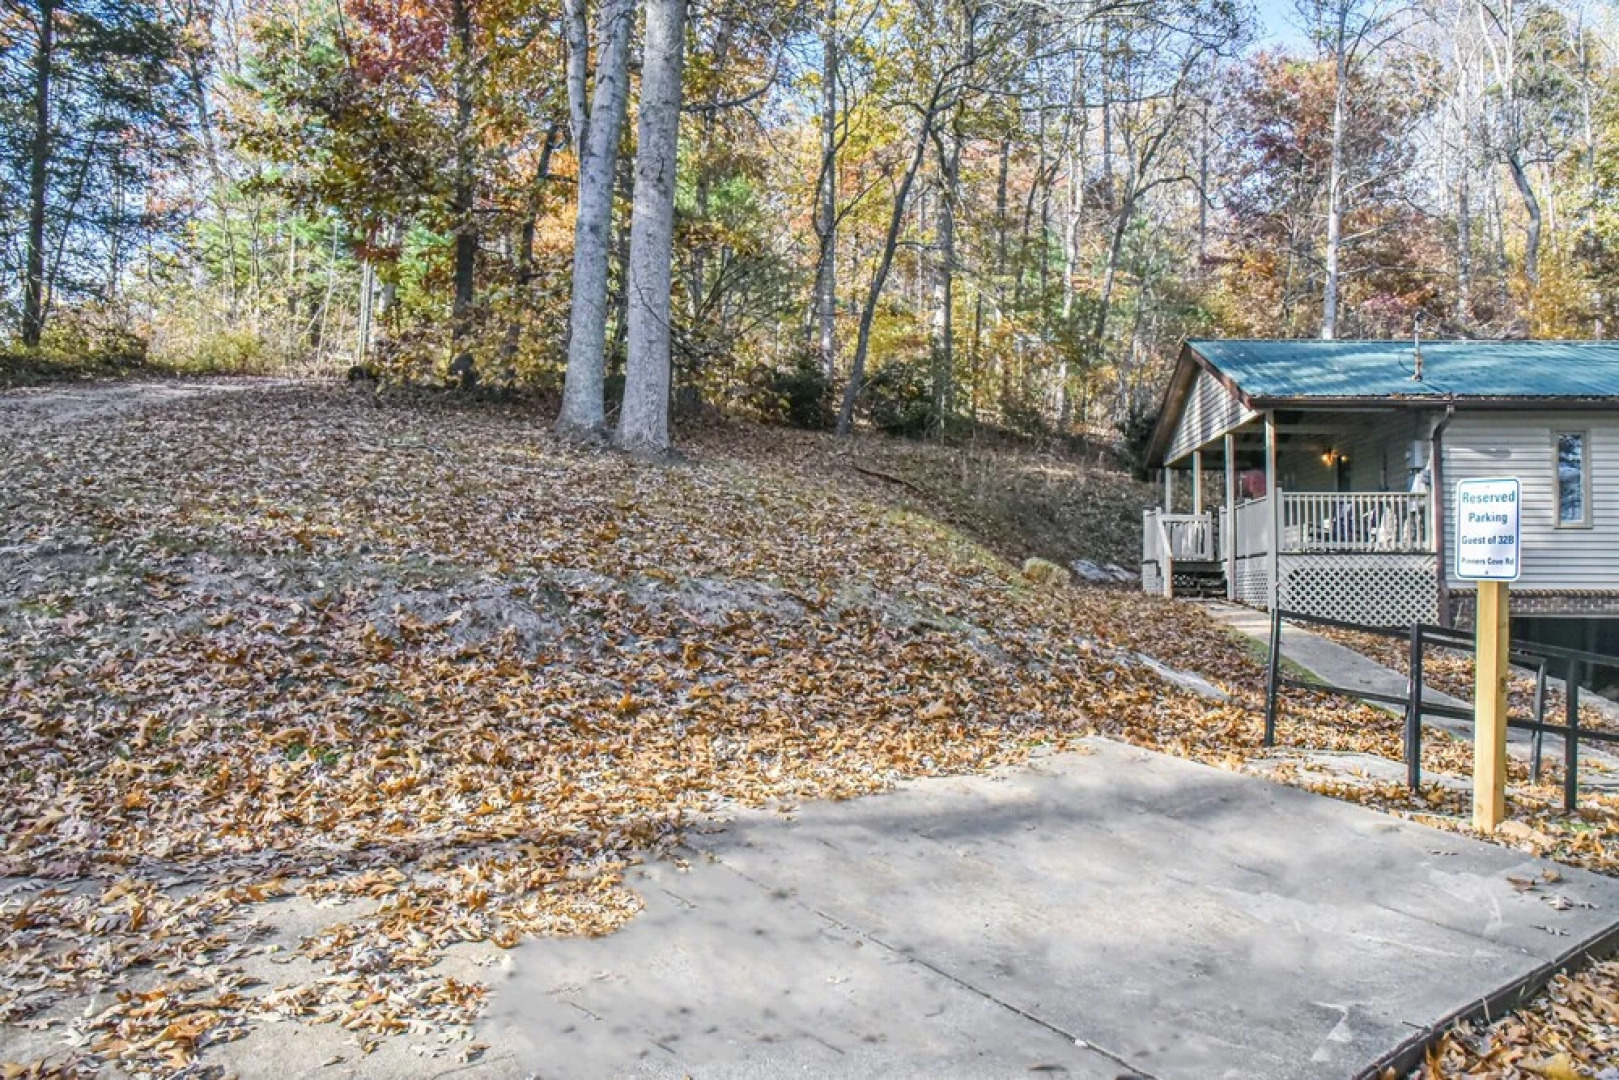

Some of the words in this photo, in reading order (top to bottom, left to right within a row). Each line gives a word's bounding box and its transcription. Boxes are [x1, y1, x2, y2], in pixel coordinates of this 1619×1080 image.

[1462, 490, 1515, 503] Reserved
[1468, 512, 1508, 525] Parking
[1462, 535, 1486, 544] Guest
[1488, 535, 1497, 544] of
[1498, 535, 1515, 544] 32B
